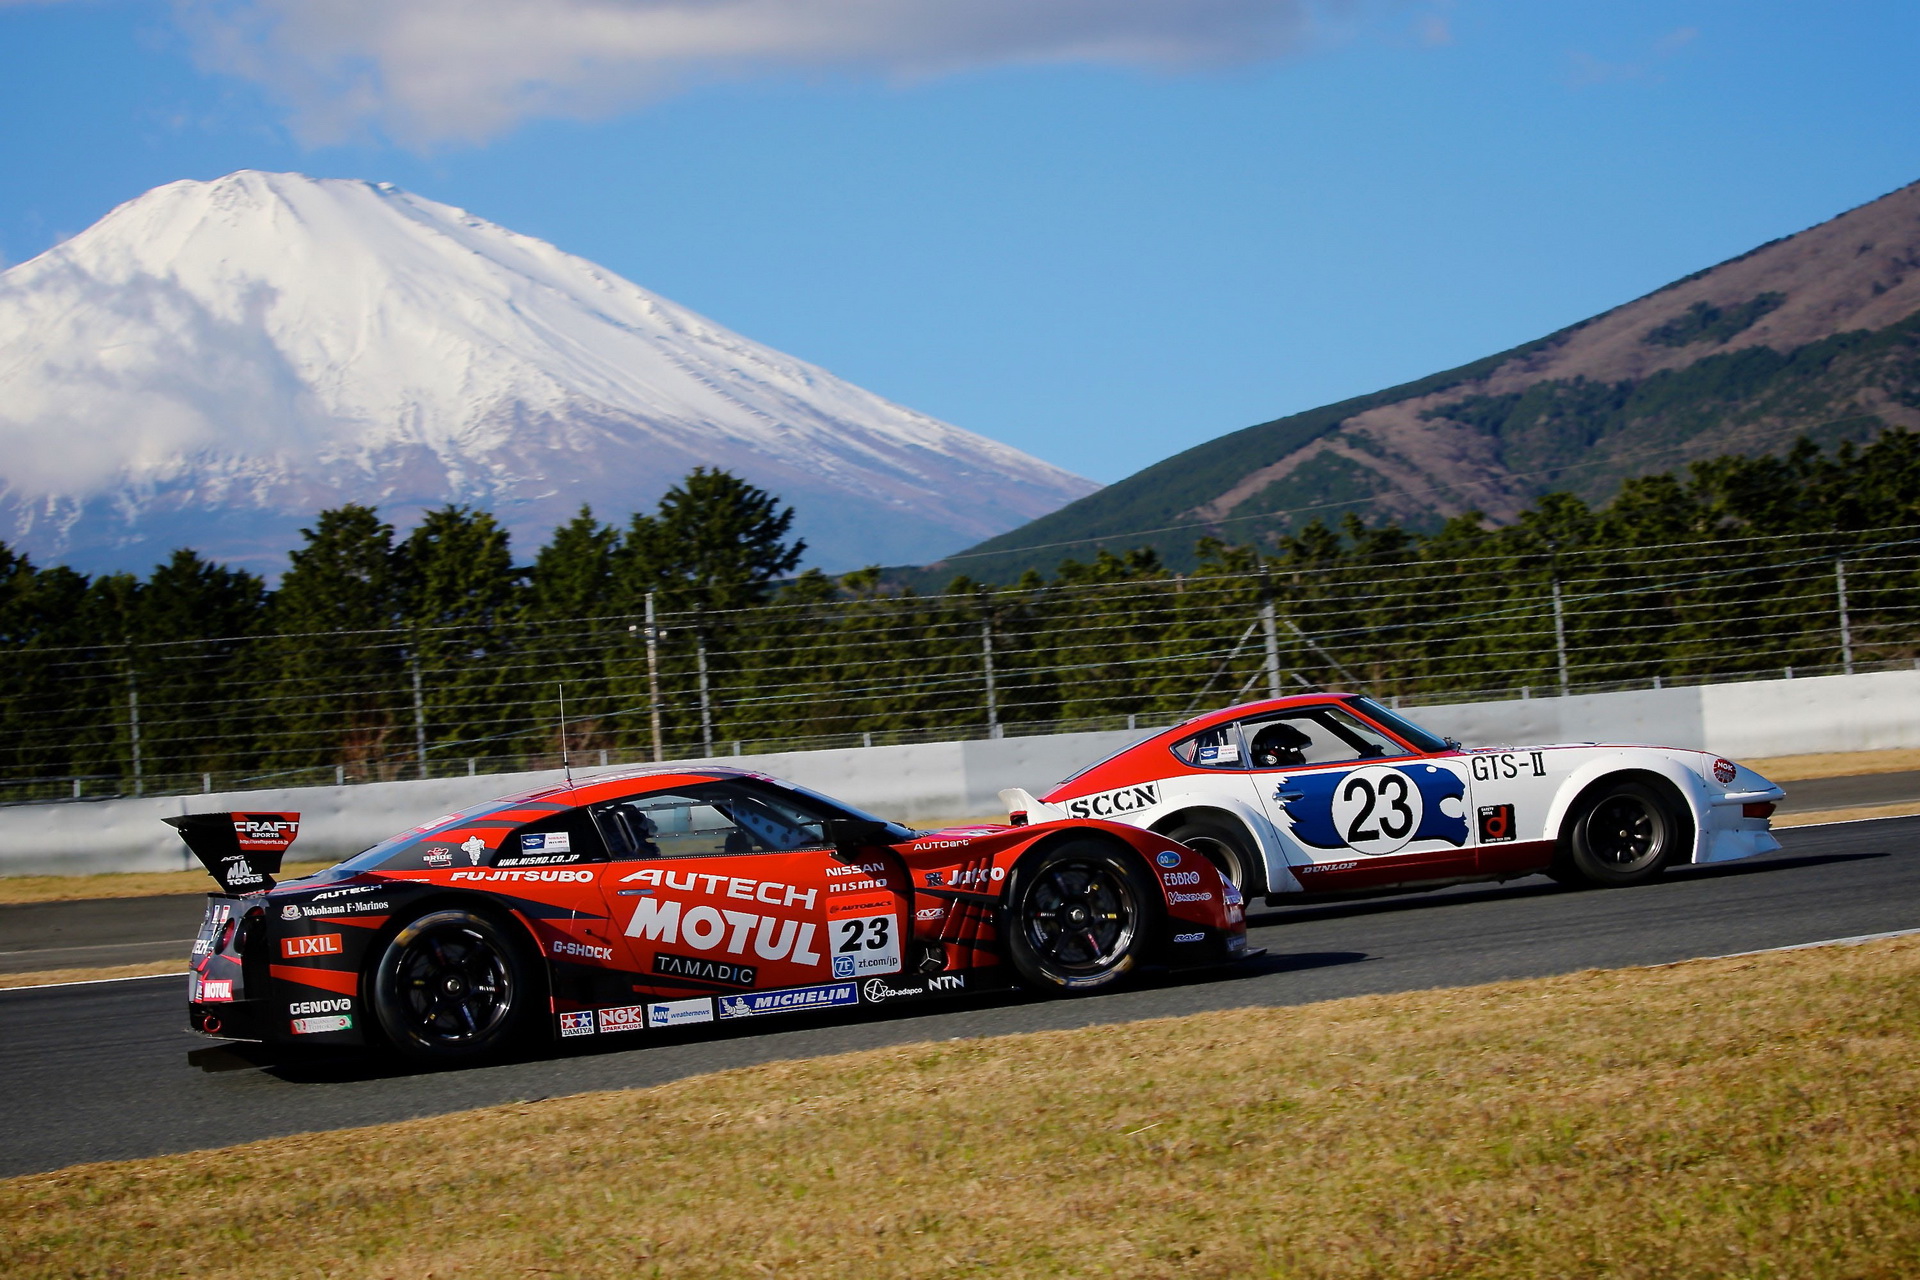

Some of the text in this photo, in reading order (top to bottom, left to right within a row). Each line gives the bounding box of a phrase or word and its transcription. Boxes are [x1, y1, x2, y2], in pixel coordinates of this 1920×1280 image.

[1070, 784, 1158, 819] SCCN
[1343, 774, 1413, 843] 23
[233, 821, 299, 832] CRAFT
[423, 854, 453, 862] BRIDE
[497, 854, 581, 867] WWW.NISMO.CO.JP
[825, 862, 885, 877] NISSAN
[1302, 862, 1358, 874] DUNLOP
[227, 876, 263, 886] TOOLS
[450, 870, 594, 883] FUJITSUBO
[1163, 871, 1200, 886] EBBRO
[312, 884, 382, 902] AUTECH
[618, 868, 819, 911] AUTECH
[829, 878, 888, 893] nismo
[302, 905, 345, 917] Yokohama
[840, 900, 892, 911] AUTOBACS
[623, 896, 821, 967] MOTUL
[838, 917, 889, 953] 23
[1174, 932, 1205, 943] RAYS
[286, 937, 338, 956] LIXIL
[553, 940, 613, 960] G-SHOCK
[858, 955, 898, 968] zf.com/jp
[203, 982, 231, 999] MOTUL
[928, 975, 964, 991] NTN
[754, 987, 851, 1009] MICHELIN
[886, 986, 923, 998] CD-adapco
[600, 1006, 641, 1026] NGK
[670, 1008, 710, 1019] weathernews
[562, 1027, 593, 1036] TAMIYA
